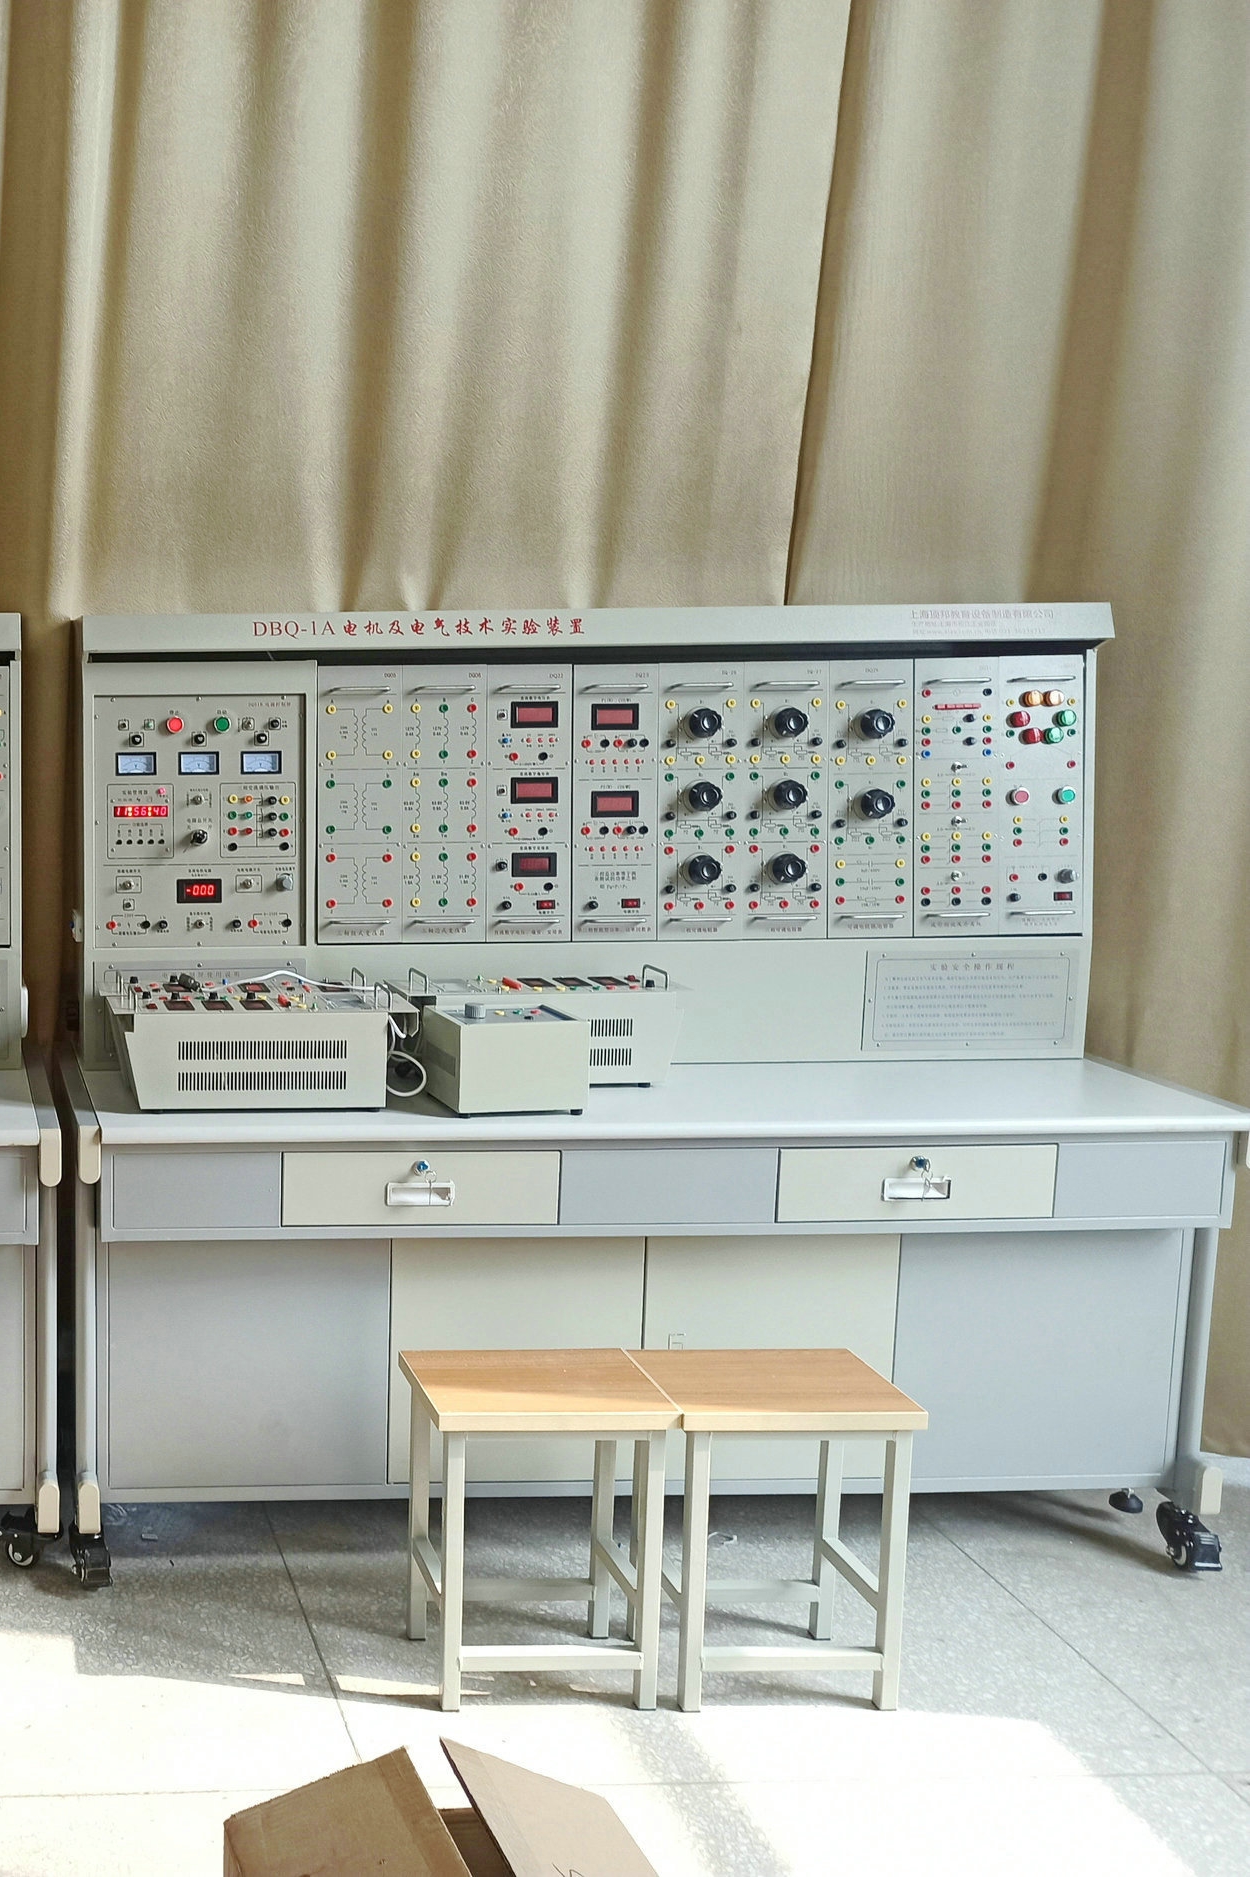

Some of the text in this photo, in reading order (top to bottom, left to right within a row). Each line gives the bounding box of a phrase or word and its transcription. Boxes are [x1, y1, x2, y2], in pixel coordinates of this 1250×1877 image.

[252, 617, 585, 639] DBQ-1A 电机及电气技术实验装置
[116, 806, 167, 816] 11:56:40
